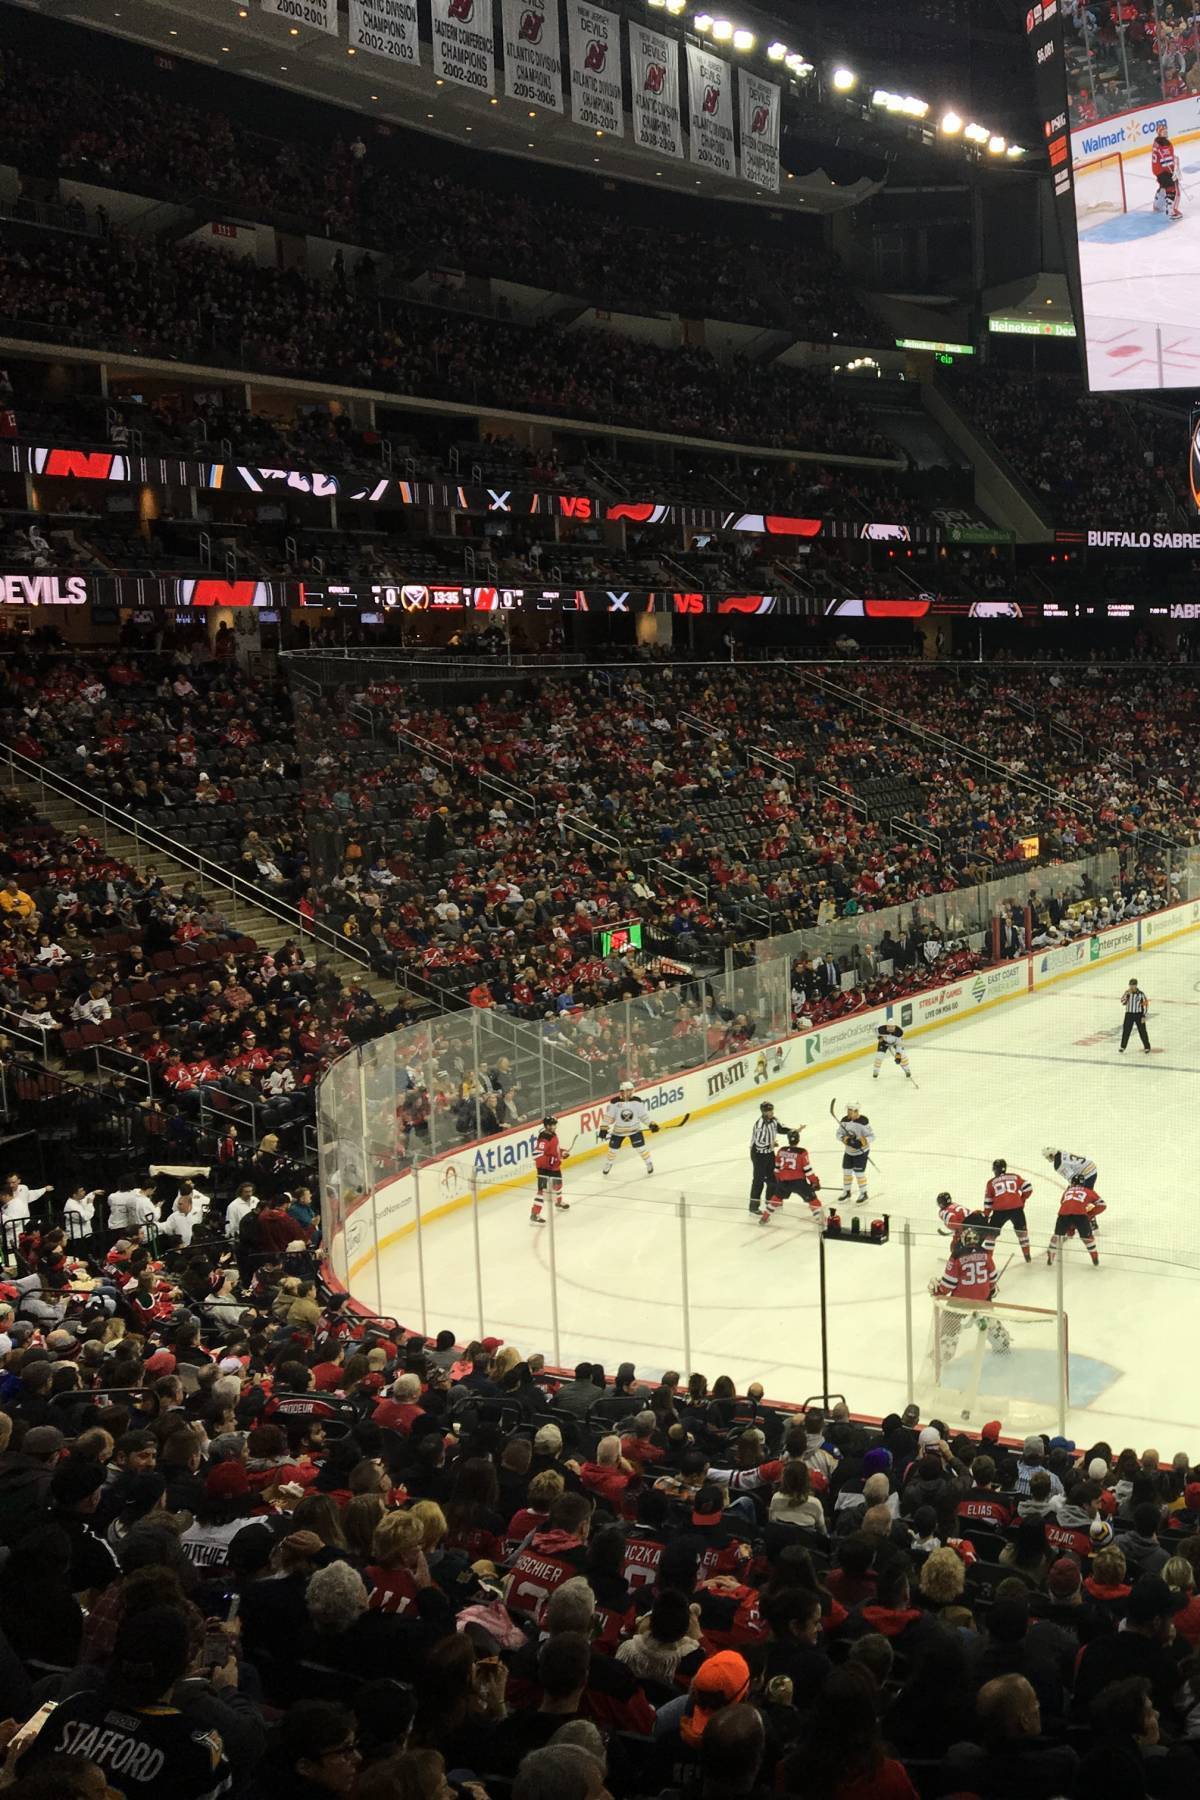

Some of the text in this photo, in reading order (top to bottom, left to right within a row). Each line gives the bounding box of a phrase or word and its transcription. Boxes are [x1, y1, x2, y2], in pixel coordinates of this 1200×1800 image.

[362, 10, 406, 39] CHAMPIONS
[581, 18, 609, 39] DEVILS
[358, 29, 414, 60] 2002-2003
[441, 41, 488, 72] CHAMPIONS
[443, 61, 488, 89] 2002-2003
[1082, 127, 1126, 154] Walmart
[990, 320, 1040, 334] Heineken
[559, 495, 591, 519] VS
[1087, 530, 1151, 548] BUFFALO
[433, 591, 458, 604] 13:35
[673, 593, 704, 613] VS
[961, 1262, 988, 1286] 35
[967, 1504, 993, 1517] ELIAS
[1048, 1527, 1075, 1547] ZAJAC
[54, 1719, 166, 1783] STAFFORD
